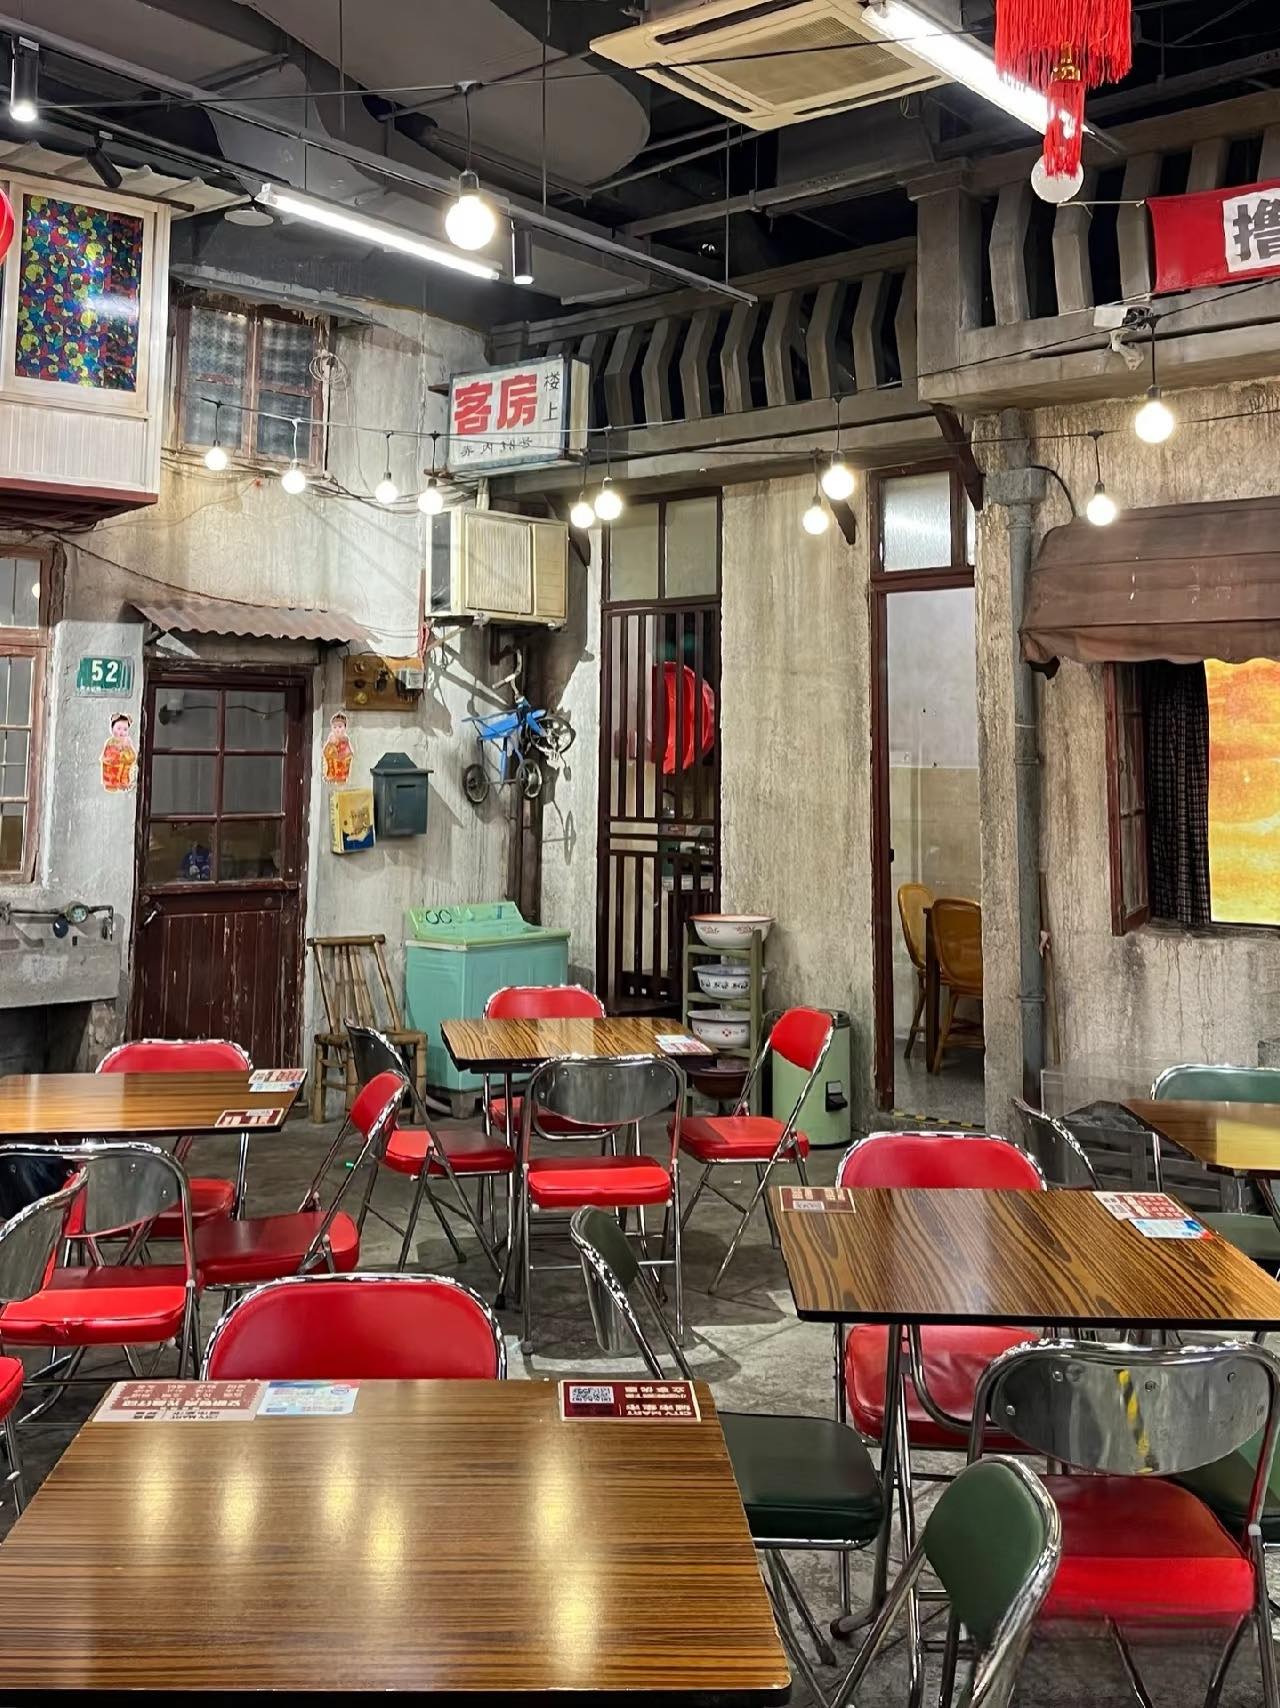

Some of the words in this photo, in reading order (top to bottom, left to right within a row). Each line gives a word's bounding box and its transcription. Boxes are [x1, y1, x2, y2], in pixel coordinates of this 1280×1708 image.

[454, 373, 538, 436] 客房
[542, 370, 560, 422] 楼上
[91, 659, 119, 682] 52
